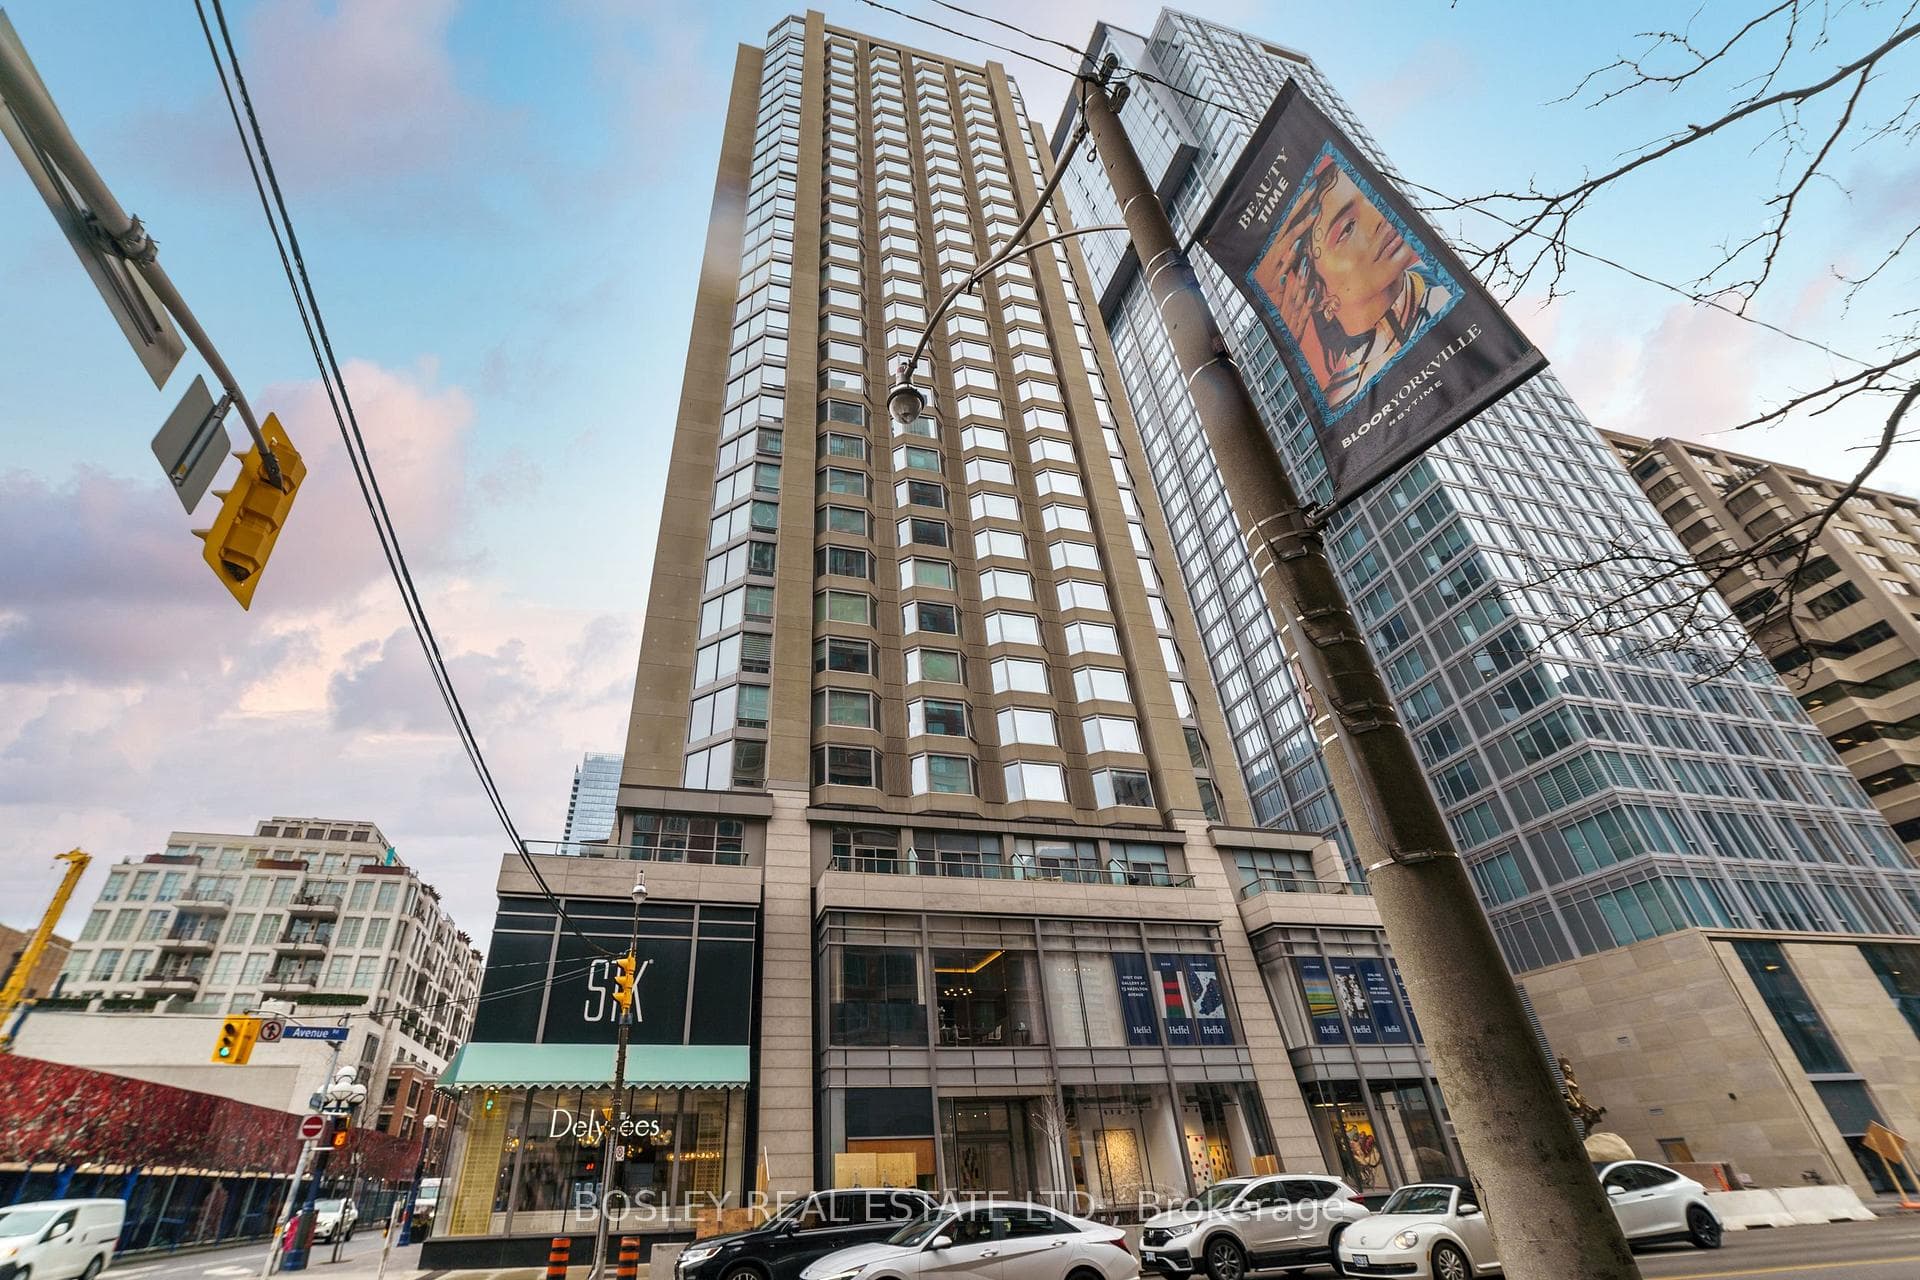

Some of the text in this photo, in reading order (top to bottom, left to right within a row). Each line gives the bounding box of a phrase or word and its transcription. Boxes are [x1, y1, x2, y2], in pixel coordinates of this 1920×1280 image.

[1237, 146, 1290, 231] BEAUTY
[1257, 176, 1290, 225] TIME
[1340, 323, 1483, 450] BLOORYORKVILLE
[292, 1028, 329, 1038] Avenue
[1133, 1025, 1153, 1034] Heffel
[1168, 1025, 1190, 1035] Heffel
[1202, 1025, 1225, 1035] Heffel
[1320, 1024, 1341, 1034] Heffel
[1352, 1024, 1372, 1034] Heffel
[549, 1109, 660, 1145] Delyées
